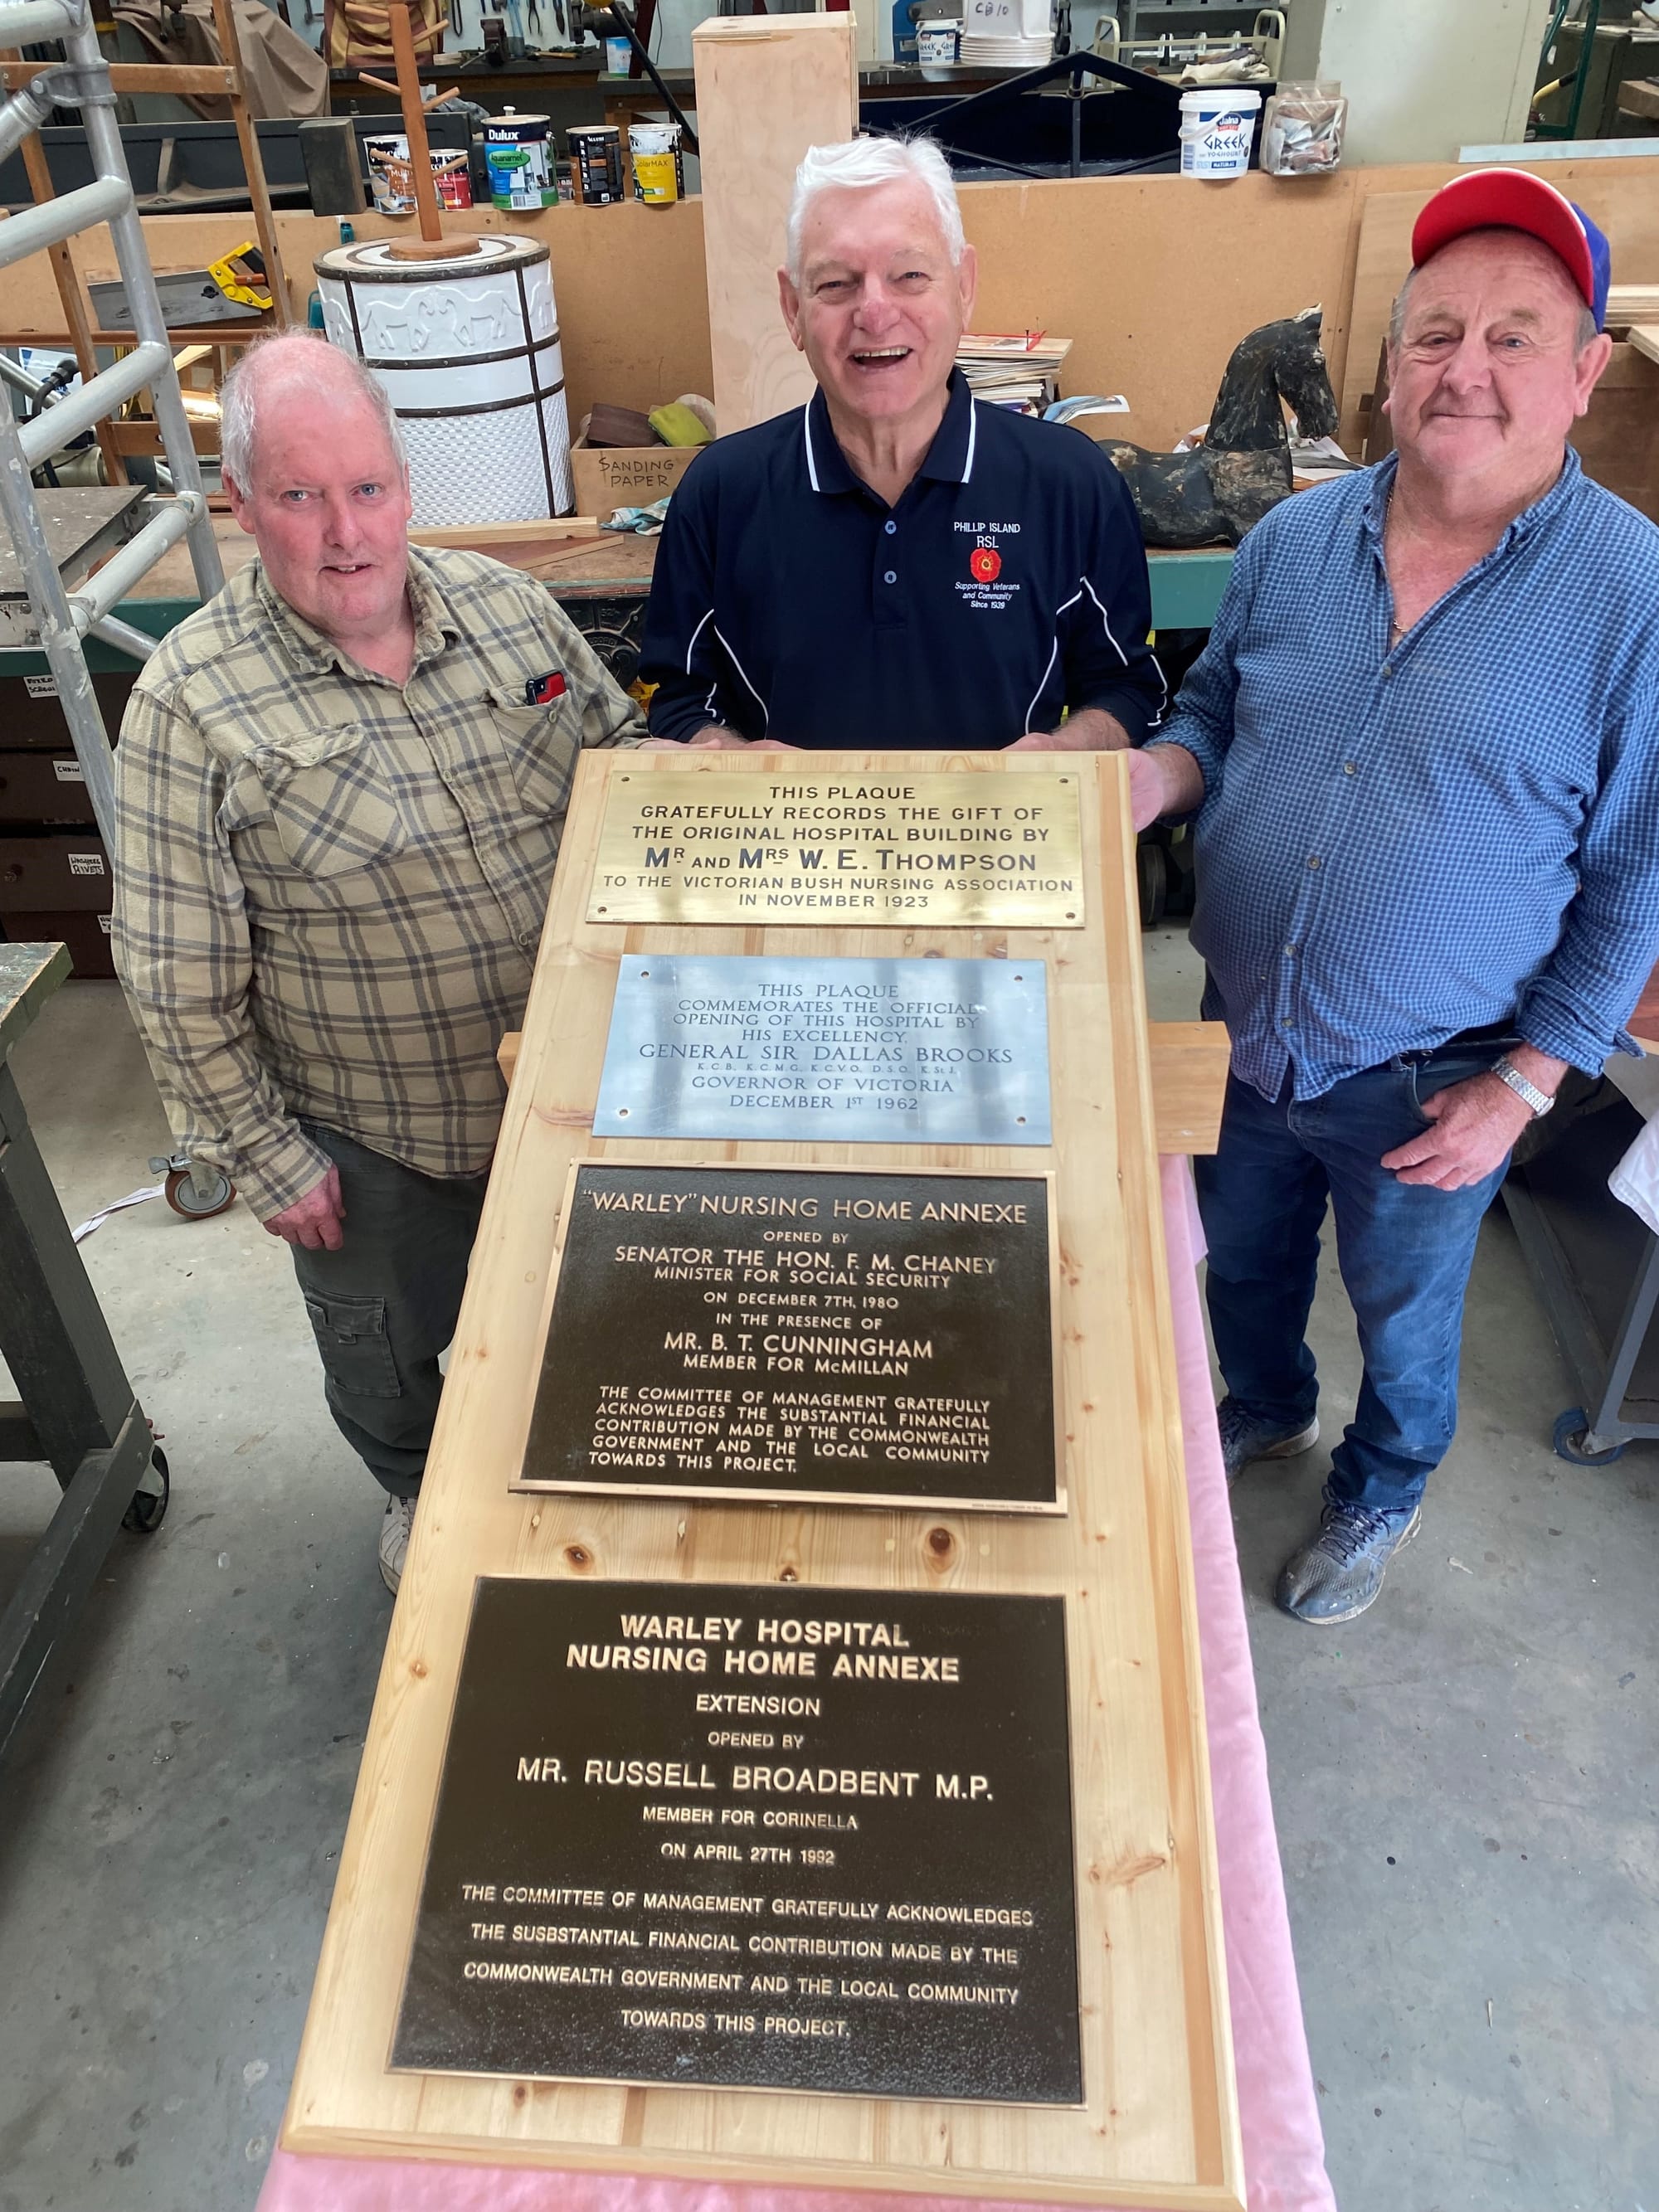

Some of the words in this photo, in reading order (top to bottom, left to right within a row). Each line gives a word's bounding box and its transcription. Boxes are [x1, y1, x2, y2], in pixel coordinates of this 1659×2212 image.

[489, 129, 518, 140] Dulux
[1204, 133, 1246, 149] GREEK
[599, 458, 674, 471] SANDING
[611, 475, 669, 487] PAPER
[954, 522, 985, 532] PHILLIP
[990, 523, 1020, 532] ISLAND
[977, 536, 999, 547] RSL
[955, 581, 990, 591] Supporting
[978, 592, 1012, 600] Community
[770, 786, 819, 800] THIS
[827, 786, 915, 800] PLAQUE
[640, 805, 774, 819] GRATEFULLY
[783, 807, 888, 820] RECORDS
[898, 807, 941, 820] THE
[951, 807, 1003, 820] GIFT
[1014, 808, 1044, 821] OF
[632, 826, 674, 839] THE
[683, 827, 785, 840] ORIGINAL
[792, 828, 899, 841] HOSPITAL
[907, 829, 1014, 842] BUILDING
[1023, 829, 1049, 842] BY
[692, 857, 731, 869] AND
[799, 849, 828, 870] W.
[837, 850, 868, 870] E.
[72, 865, 103, 873] RIVETS
[604, 876, 629, 888] TO
[637, 876, 672, 888] THE
[684, 877, 784, 889] VICTORIAN
[791, 878, 844, 890] BUSH
[850, 878, 935, 891] NURSING
[944, 879, 1073, 892] ASSOCIATION
[739, 894, 757, 906] IN
[767, 895, 875, 907] NOVEMBER
[885, 896, 928, 908] 1923
[758, 984, 805, 997] THIS
[816, 984, 899, 999] PLAQUE
[679, 999, 834, 1014] COMMEMORATES
[842, 1001, 879, 1014] THE
[890, 1002, 977, 1014] OFFICIAL
[674, 1014, 760, 1027] OPENING
[768, 1014, 794, 1027] OF
[804, 1014, 845, 1028] THIS
[854, 1014, 945, 1028] HOSPITAL
[956, 1016, 979, 1028] BY
[742, 1029, 772, 1042] HIS
[640, 1044, 749, 1060] GENERAL
[762, 1045, 798, 1061] SIR
[814, 1045, 903, 1062] DALLAS
[917, 1047, 1014, 1063] BROOKS
[693, 1076, 809, 1090] GOVERNOR
[817, 1077, 845, 1091] OF
[854, 1078, 954, 1092] VICTORIA
[730, 1095, 834, 1108] DECEMBER
[877, 1096, 918, 1110] 1962
[700, 1195, 820, 1218] NURSING
[833, 1199, 912, 1220] HOME
[920, 1202, 1028, 1224] ANNEXE
[615, 1246, 714, 1266] SENATOR
[723, 1249, 764, 1266] THE
[776, 1251, 834, 1269] HON.
[846, 1252, 859, 1270] F.
[871, 1252, 896, 1271] M.
[904, 1255, 996, 1275] CHANEY
[654, 1265, 733, 1282] MINISTER
[744, 1268, 781, 1283] FOR
[789, 1269, 858, 1286] SOCIAL
[865, 1271, 951, 1289] SECURITY
[703, 1291, 727, 1304] ON
[737, 1292, 818, 1307] DECEMBER
[862, 1296, 899, 1310] 1980
[716, 1313, 732, 1325] IN
[742, 1313, 770, 1327] THE
[777, 1314, 854, 1329] PRESENCE
[861, 1316, 883, 1330] OF
[664, 1331, 703, 1351] MR.
[711, 1333, 729, 1351] B.
[737, 1334, 753, 1353] T.
[763, 1334, 933, 1359] CUNNINGHAM
[684, 1354, 757, 1371] MEMBER
[766, 1356, 805, 1372] FOR
[815, 1359, 909, 1377] McMILLAN
[600, 1386, 630, 1399] THE
[638, 1387, 732, 1404] COMMITTEE
[742, 1390, 765, 1404] OF
[771, 1391, 887, 1407] MANAGEMENT
[894, 1397, 990, 1413] GRATEFULLY
[596, 1402, 726, 1419] ACKNOWLEDGES
[737, 1406, 768, 1420] THE
[780, 1407, 888, 1425] SUBSTANTIAL
[898, 1412, 990, 1430] FINANCIAL
[620, 1613, 742, 1643] WARLEY
[757, 1617, 910, 1647] HOSPITAL
[566, 1643, 708, 1673] NURSING
[723, 1647, 816, 1676] HOME
[832, 1655, 960, 1682] ANNEXE
[695, 1694, 821, 1716] EXTENSION
[707, 1731, 774, 1748] OPENED
[782, 1733, 804, 1750] BY
[517, 1757, 567, 1783] MR.
[584, 1759, 716, 1790] RUSSELL
[732, 1766, 919, 1796] BROADBENT
[934, 1773, 995, 1799] M.P.
[642, 1806, 713, 1824] MEMBER
[721, 1809, 755, 1825] FOR
[762, 1811, 859, 1830] CORINELLA
[661, 1841, 687, 1859] ON
[693, 1843, 742, 1862] APRIL
[750, 1845, 791, 1863] 27TH
[800, 1848, 835, 1865] 1992
[462, 1884, 496, 1902] THE
[502, 1886, 605, 1906] COMMITTEE
[611, 1889, 636, 1907] OF
[643, 1891, 763, 1914] MANAGEMENT
[771, 1896, 878, 1919] GRATEFULLY
[886, 1903, 1034, 1926] ACKNOWLEDGES
[470, 1923, 504, 1940] THE
[512, 1924, 641, 1947] SUSBSTANTIAL
[648, 1929, 741, 1951] FINANCIAL
[747, 1933, 883, 1958] CONTRIBUTION
[890, 1940, 942, 1961] MADE
[950, 1944, 975, 1962] BY
[982, 1946, 1018, 1964] THE
[464, 1961, 613, 1986] COMMONWEALTH
[620, 1966, 743, 1991] GOVERNMENT
[750, 1973, 790, 1992] AND
[797, 1976, 833, 1994] THE
[839, 1978, 899, 1998] LOCAL
[907, 1981, 1019, 2005] COMMUNITY
[620, 2009, 707, 2030] TOWARDS
[714, 2012, 756, 2032] THIS
